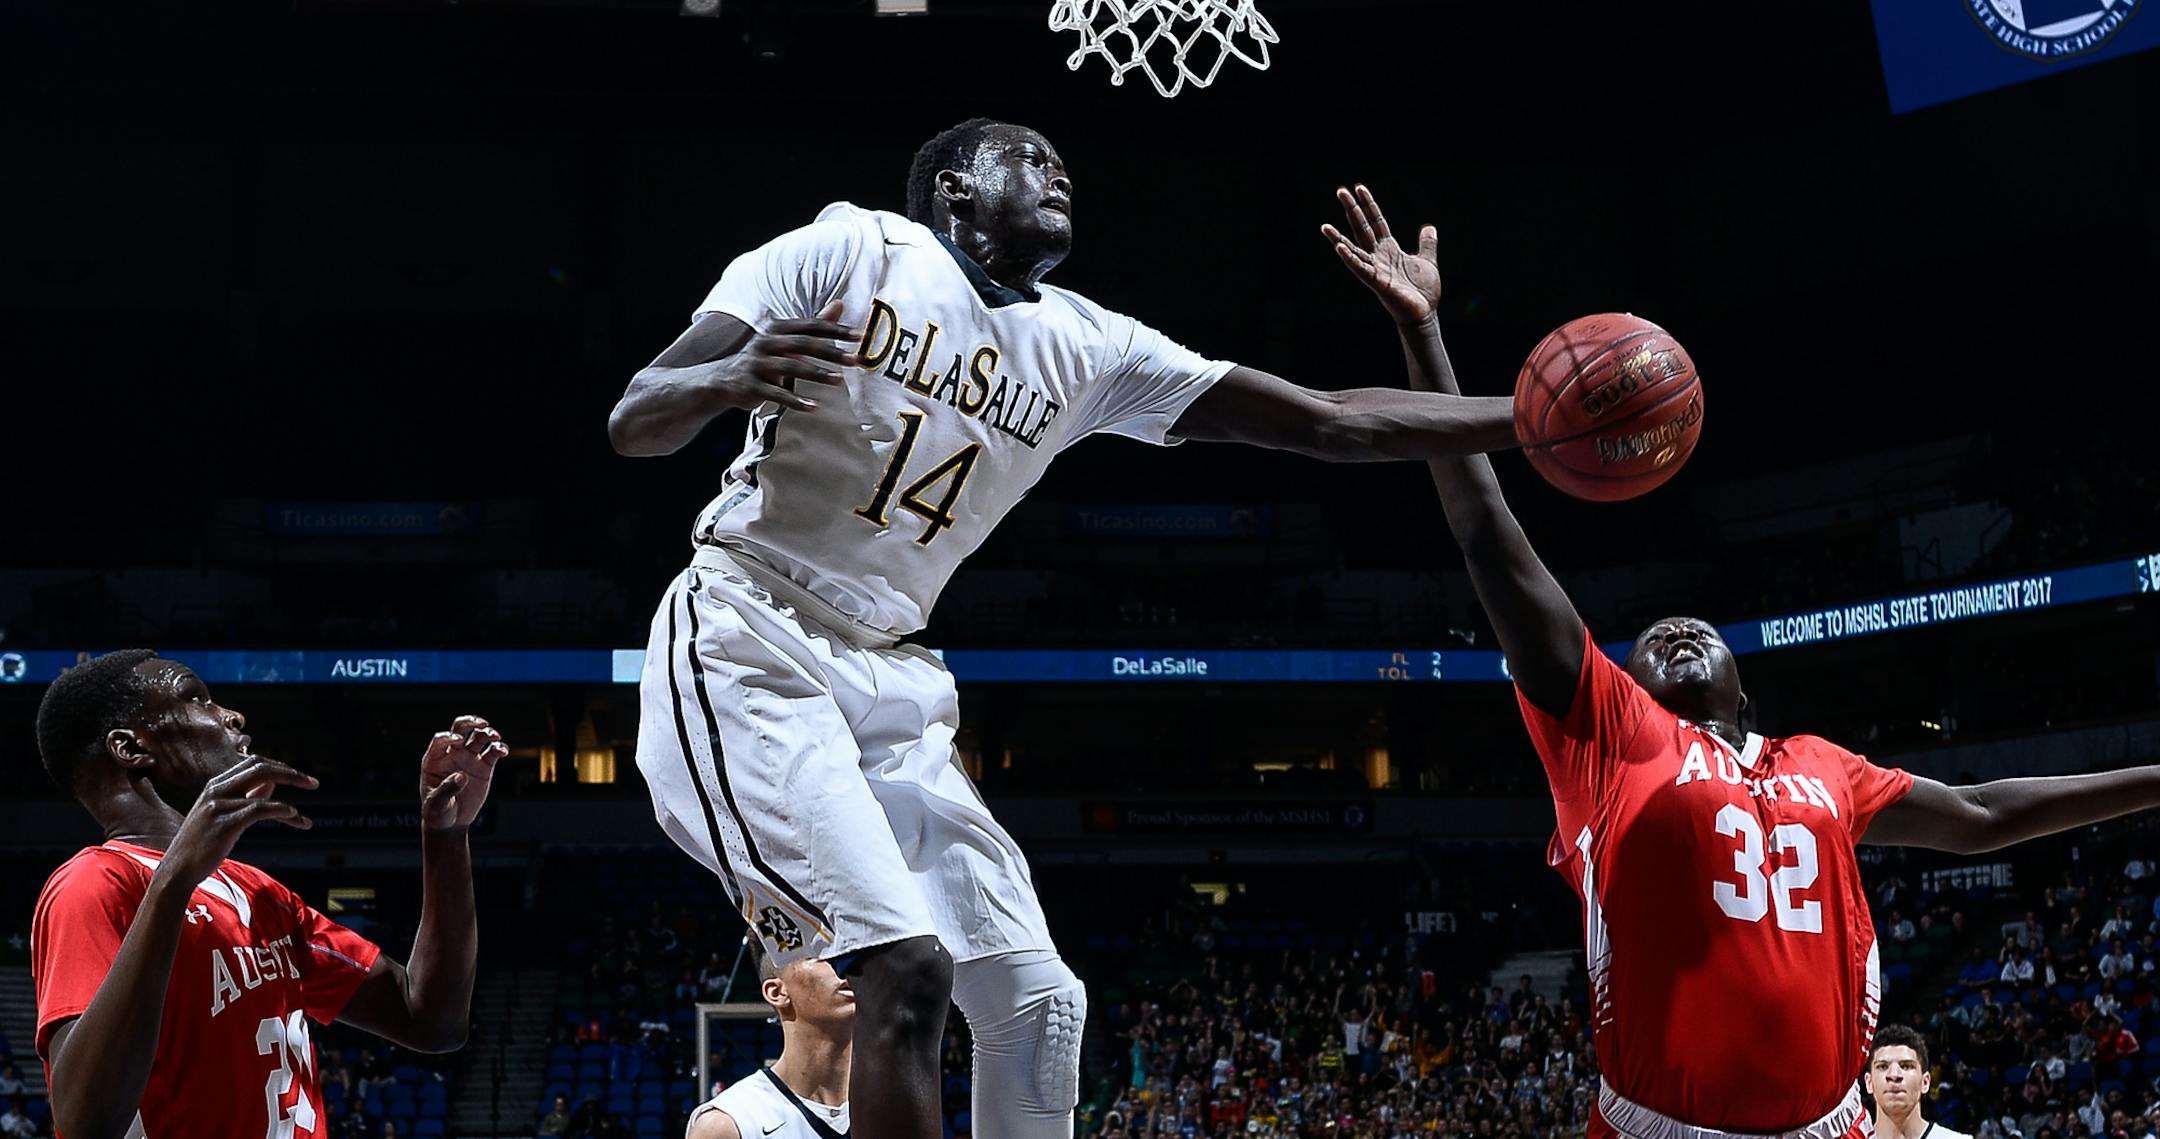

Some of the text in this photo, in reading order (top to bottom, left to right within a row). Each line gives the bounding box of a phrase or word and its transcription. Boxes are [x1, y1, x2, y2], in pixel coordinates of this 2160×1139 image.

[1996, 25, 2048, 55] HIGH
[2052, 9, 2128, 56] SCHOOL
[853, 410, 983, 547] 14
[1761, 576, 2052, 648] WELCOME TO MSHSL STATE TOURNAMENT 2017
[331, 659, 408, 678] AUSTIN
[1113, 656, 1208, 675] DeLaSalle
[1432, 651, 1441, 666] 2
[1127, 810, 1170, 824] Proud
[1174, 810, 1232, 828] Sponsor
[1236, 809, 1250, 824] of
[1253, 809, 1275, 824] the
[1713, 803, 1823, 934] 32
[211, 935, 300, 1018] AUST
